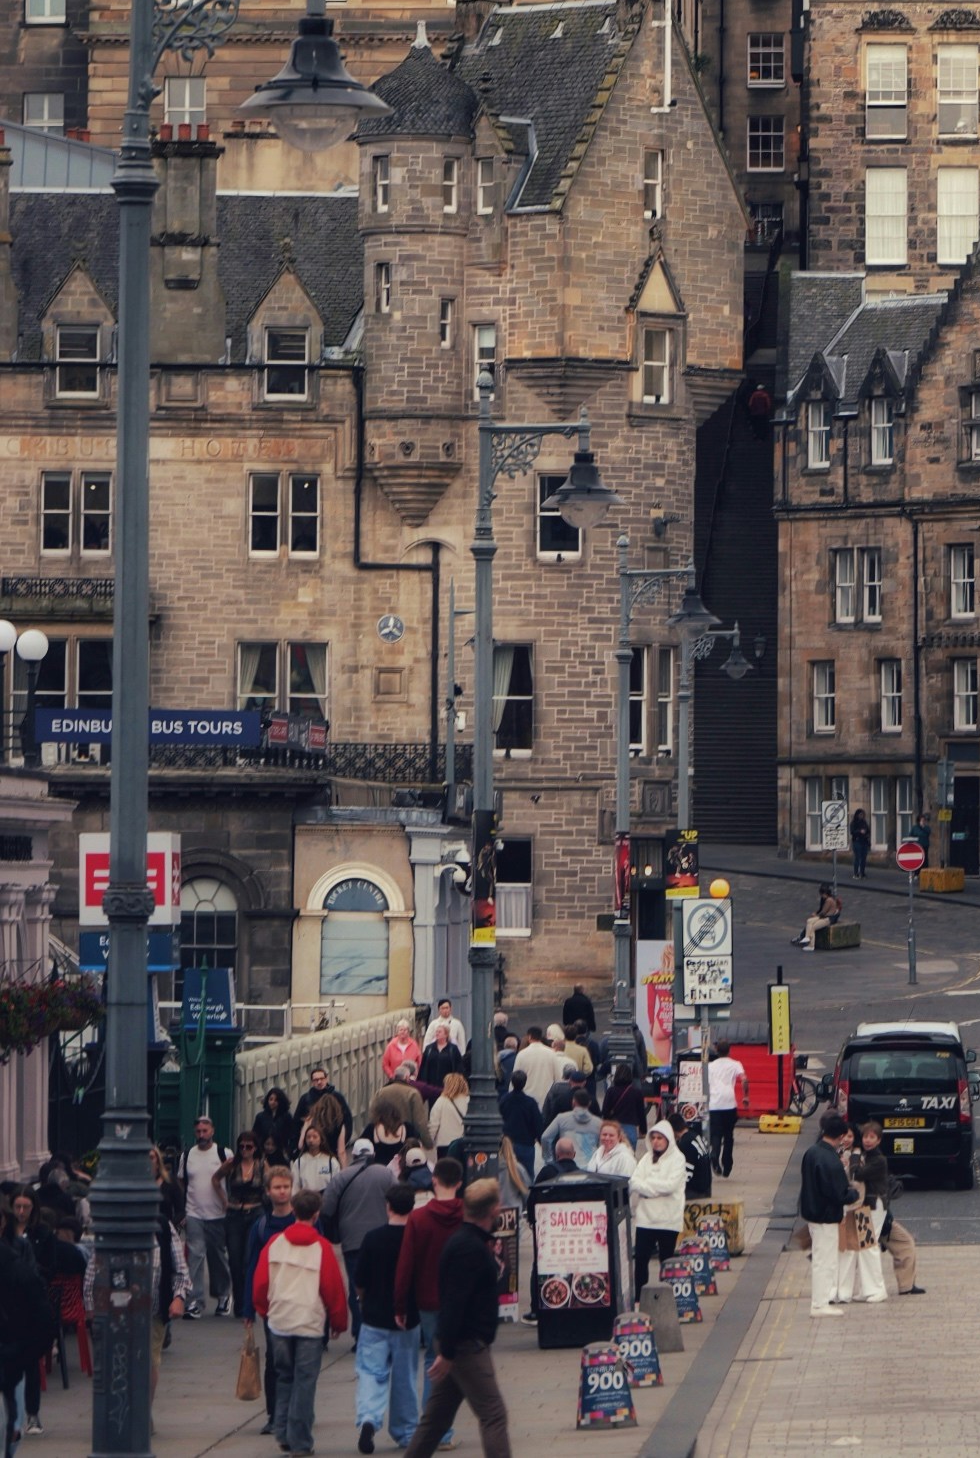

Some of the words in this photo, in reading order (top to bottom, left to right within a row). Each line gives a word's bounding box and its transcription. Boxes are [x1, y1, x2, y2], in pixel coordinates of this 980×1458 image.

[51, 718, 112, 734] EDINBU
[151, 720, 183, 734] BUS
[188, 720, 243, 735] TOURS
[921, 1096, 957, 1110] TAXI
[672, 1282, 692, 1297] 00
[619, 1339, 652, 1358] 900
[587, 1371, 625, 1394] 900
